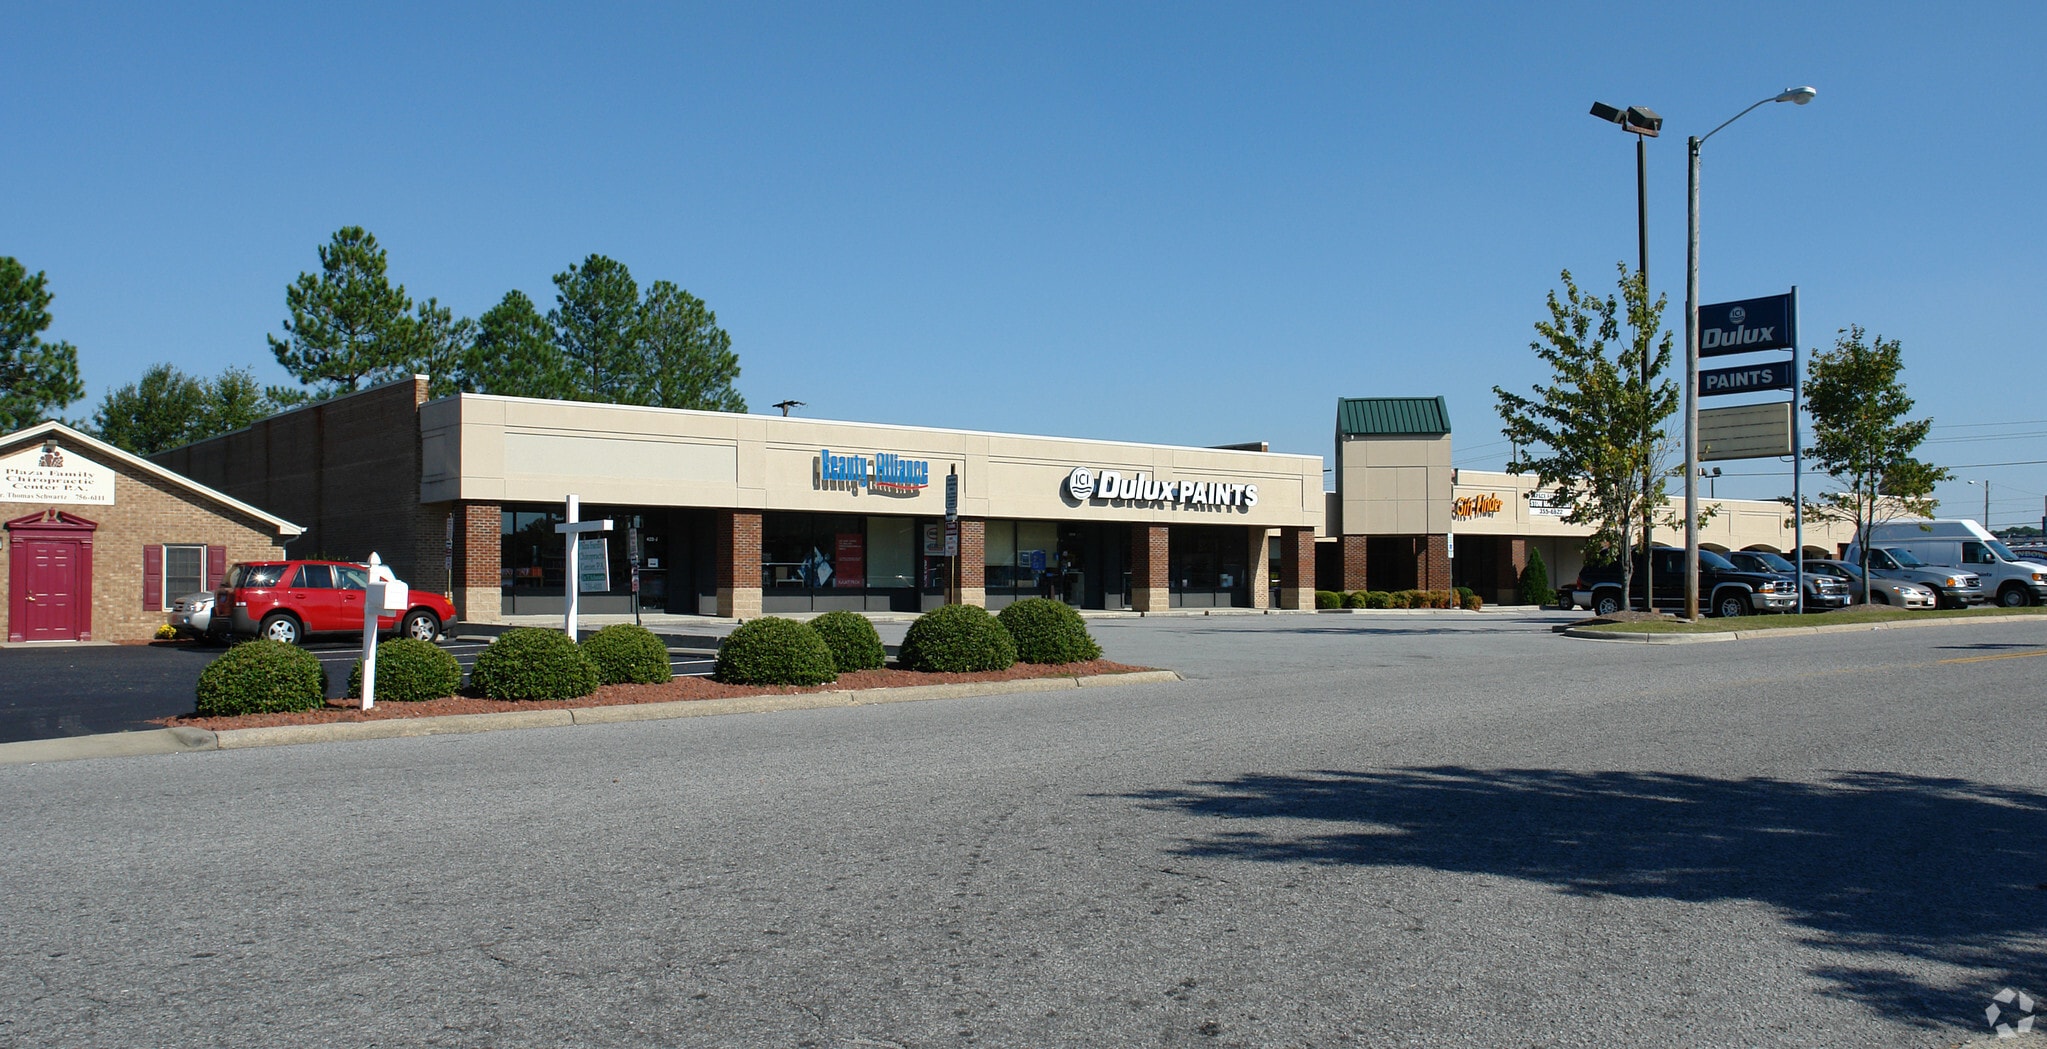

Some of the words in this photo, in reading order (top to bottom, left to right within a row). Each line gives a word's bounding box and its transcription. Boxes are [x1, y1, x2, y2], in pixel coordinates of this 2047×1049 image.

[1732, 309, 1742, 317] ICI
[1702, 324, 1775, 349] Dulux
[1706, 369, 1773, 390] PAINTS
[6, 468, 43, 476] Plaza
[49, 470, 95, 478] Family
[822, 449, 867, 488] Beauty
[876, 452, 928, 485] Alliance
[1075, 473, 1089, 485] ICI
[6, 475, 95, 485] Chiropractic
[1097, 470, 1175, 501] Dulux
[1179, 480, 1259, 507] PAINTS
[1456, 496, 1473, 517] Gift
[1475, 492, 1503, 515] Finder
